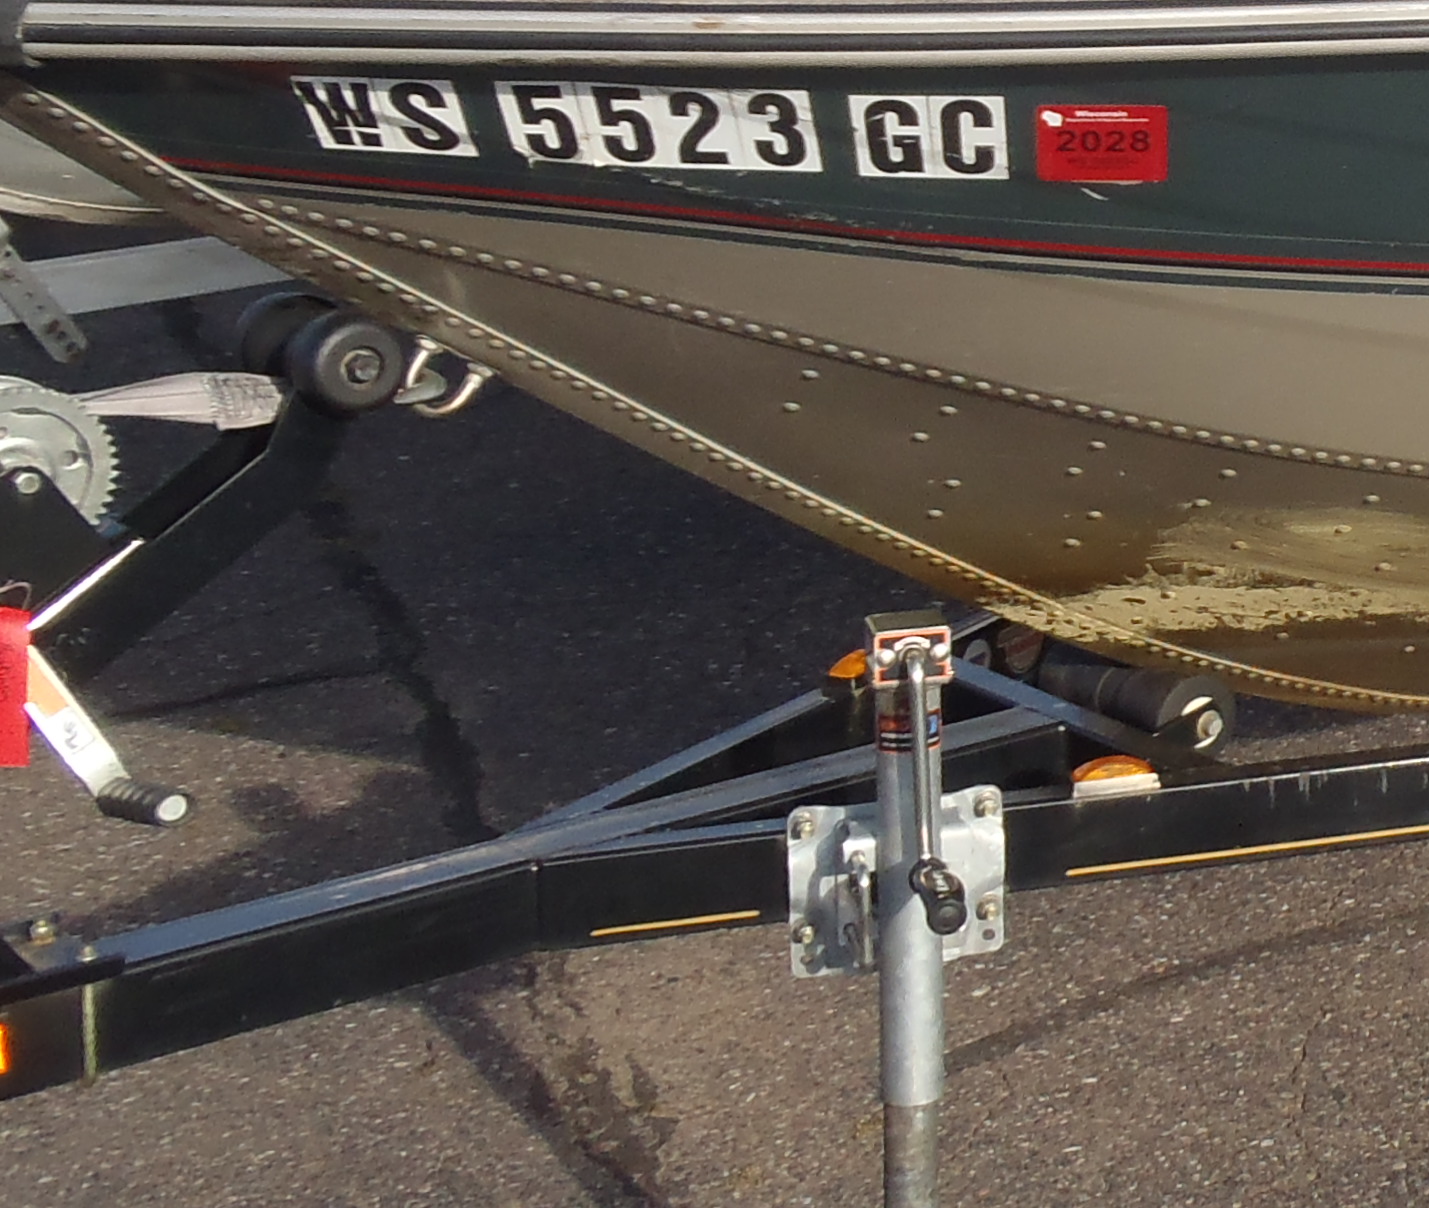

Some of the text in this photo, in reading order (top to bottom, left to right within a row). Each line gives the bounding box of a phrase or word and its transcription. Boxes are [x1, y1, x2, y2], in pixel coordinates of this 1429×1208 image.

[298, 80, 998, 174] WS 5523 GC
[1055, 129, 1150, 153] 2028
